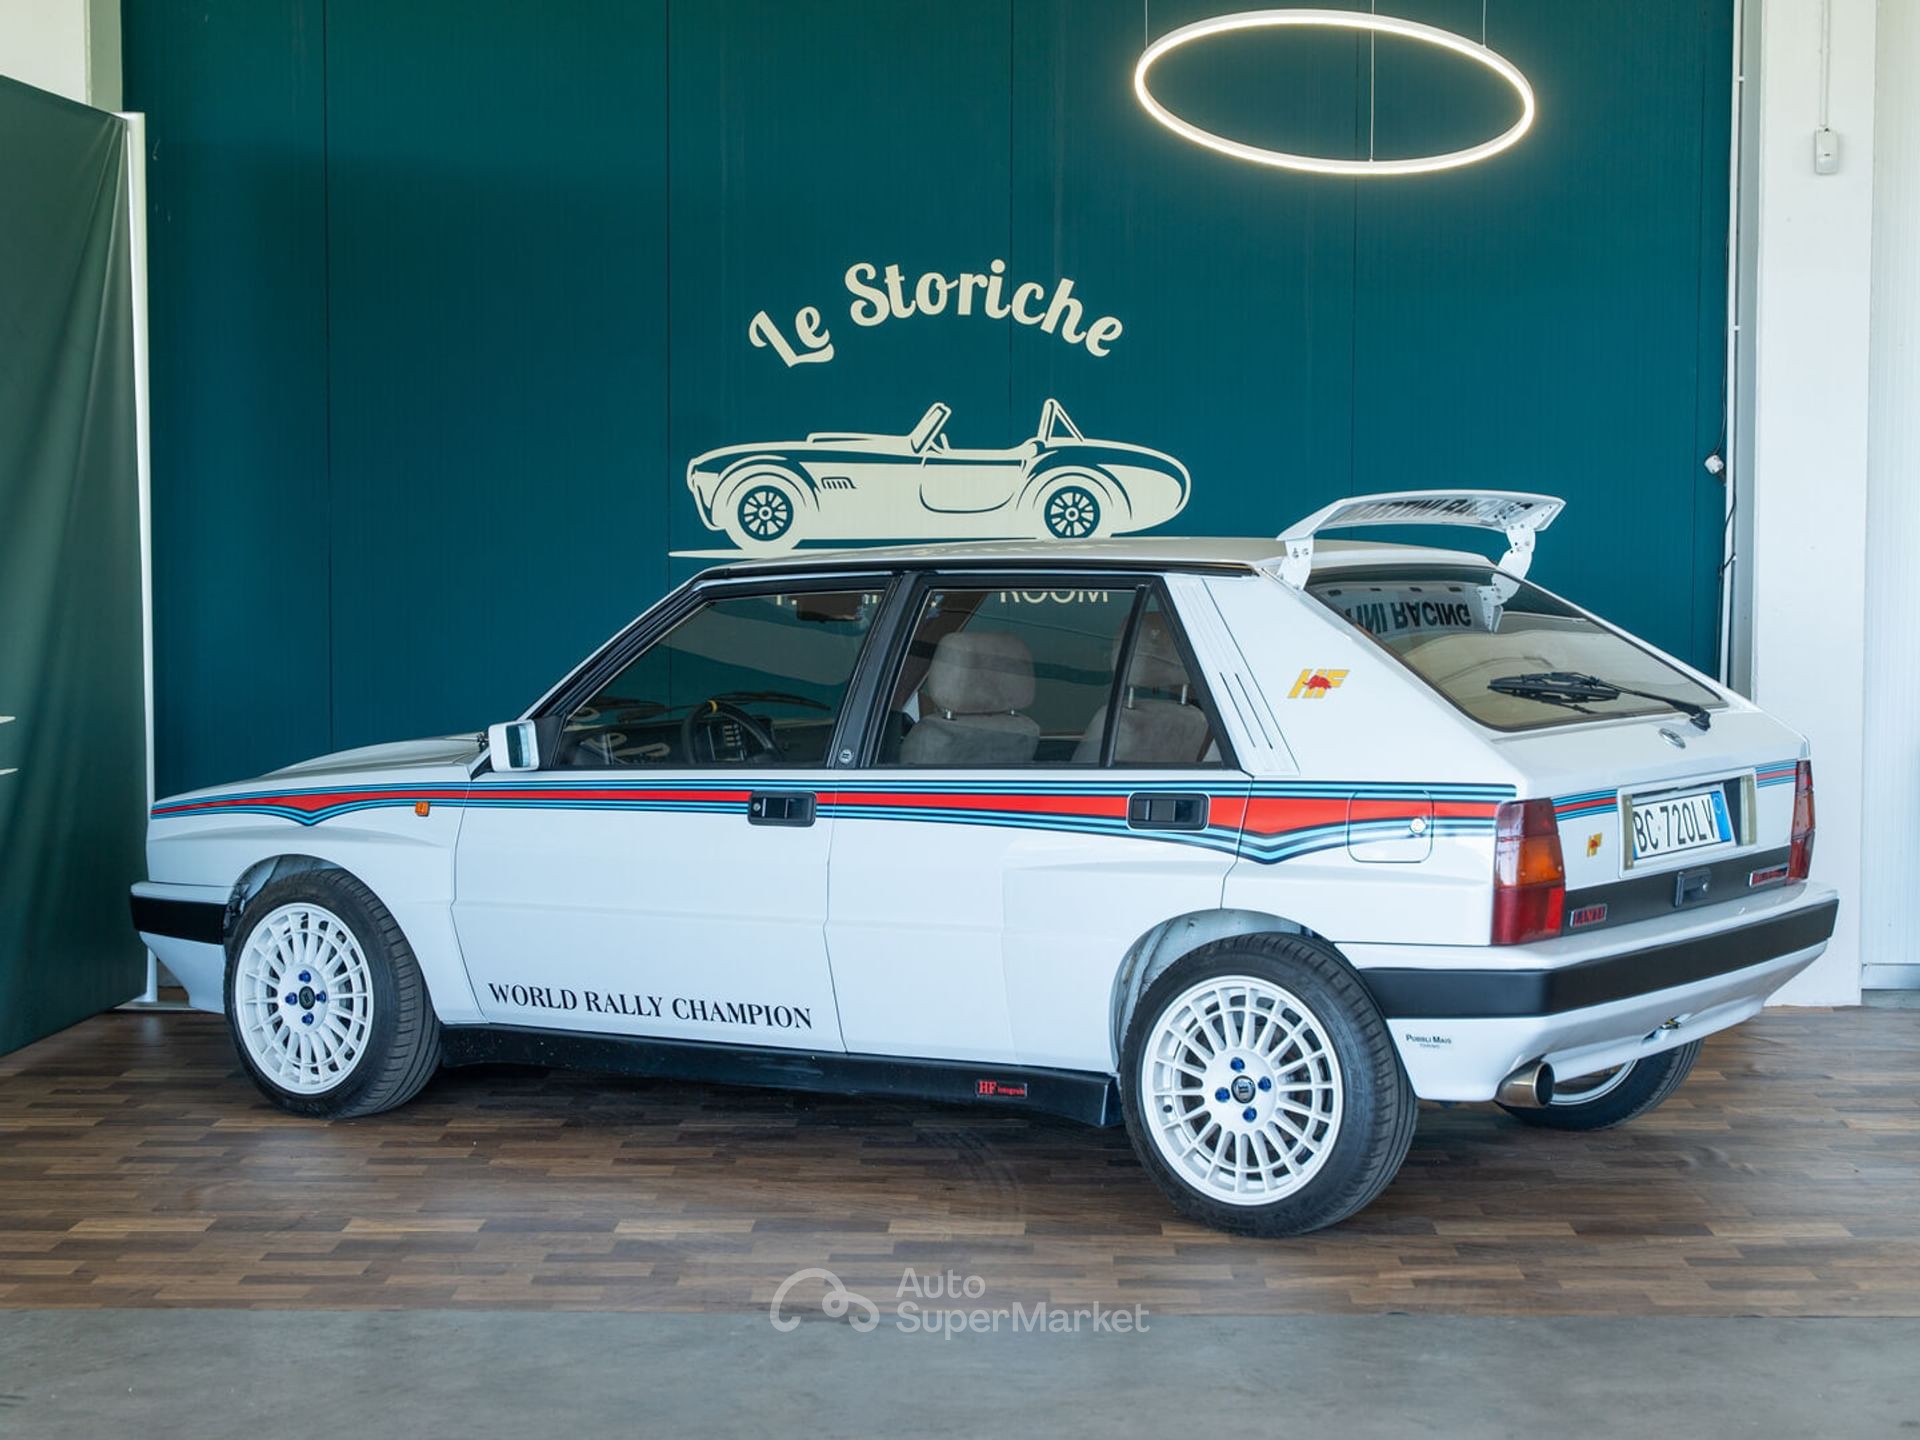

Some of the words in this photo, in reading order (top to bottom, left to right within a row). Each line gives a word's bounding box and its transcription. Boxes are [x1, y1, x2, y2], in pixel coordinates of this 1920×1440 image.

[748, 305, 835, 367] Le
[844, 259, 1123, 357] Storiche
[1287, 669, 1350, 699] HF
[488, 982, 578, 1011] WORLD
[583, 991, 663, 1018] RALLY
[671, 998, 813, 1029] CHAMPION
[979, 1080, 998, 1095] HF
